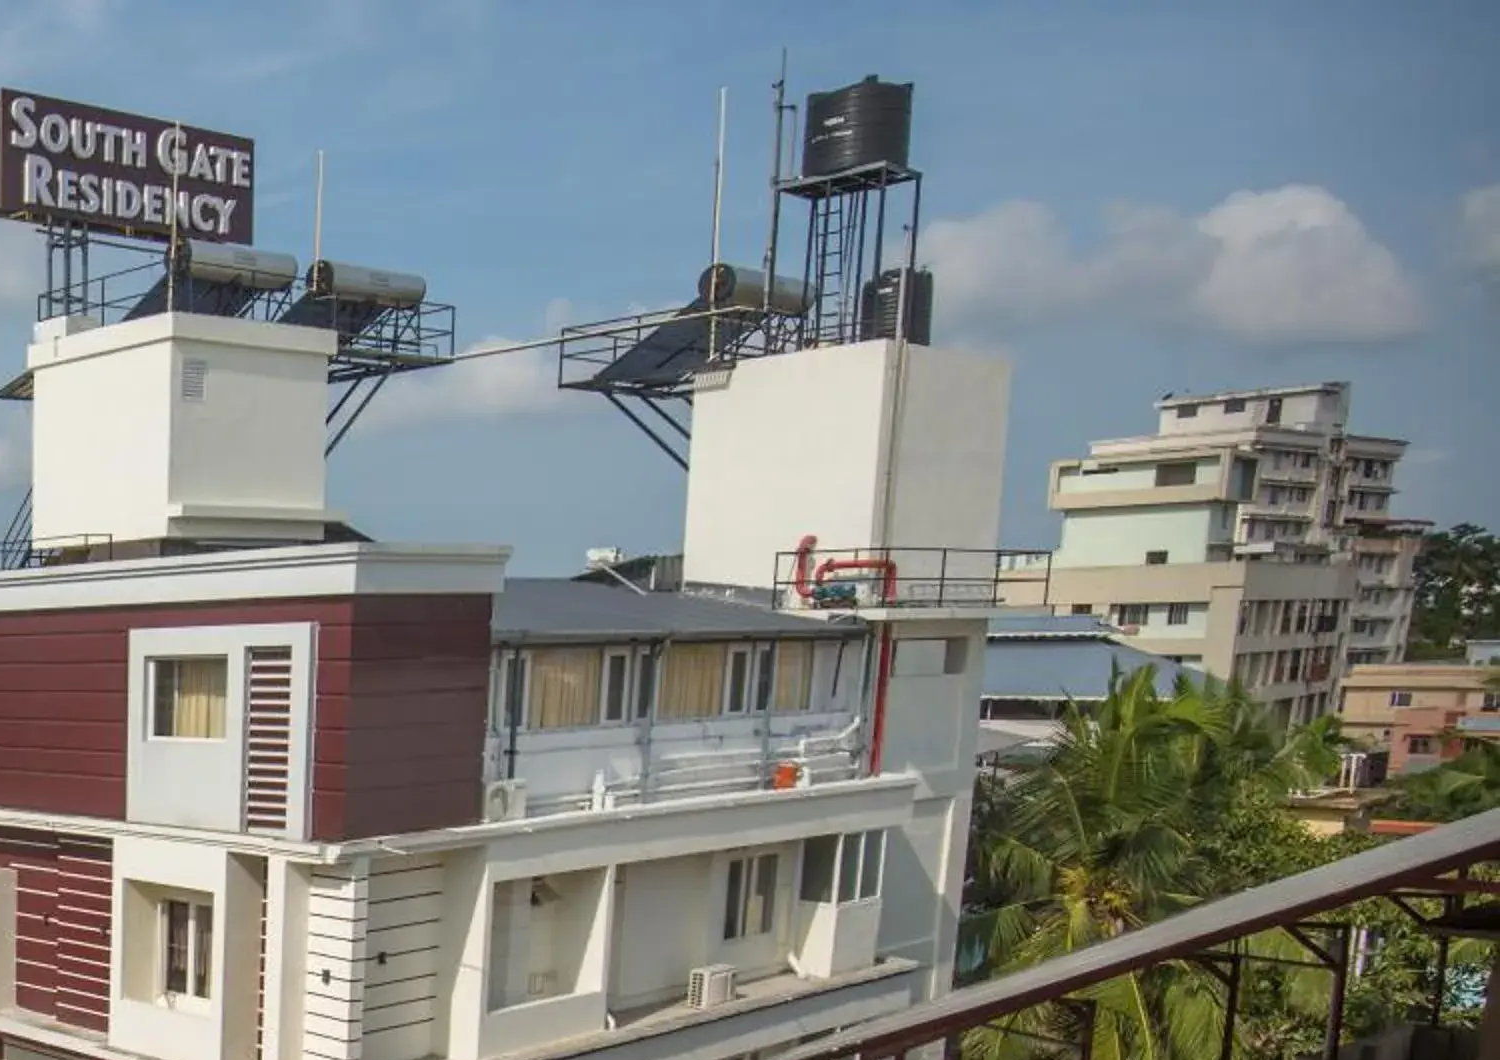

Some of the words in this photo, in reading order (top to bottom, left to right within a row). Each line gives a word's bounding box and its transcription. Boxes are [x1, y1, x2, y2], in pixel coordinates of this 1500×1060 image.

[10, 97, 147, 168] SOUTH
[157, 127, 251, 188] GATE
[23, 153, 238, 235] RESIDENCY
